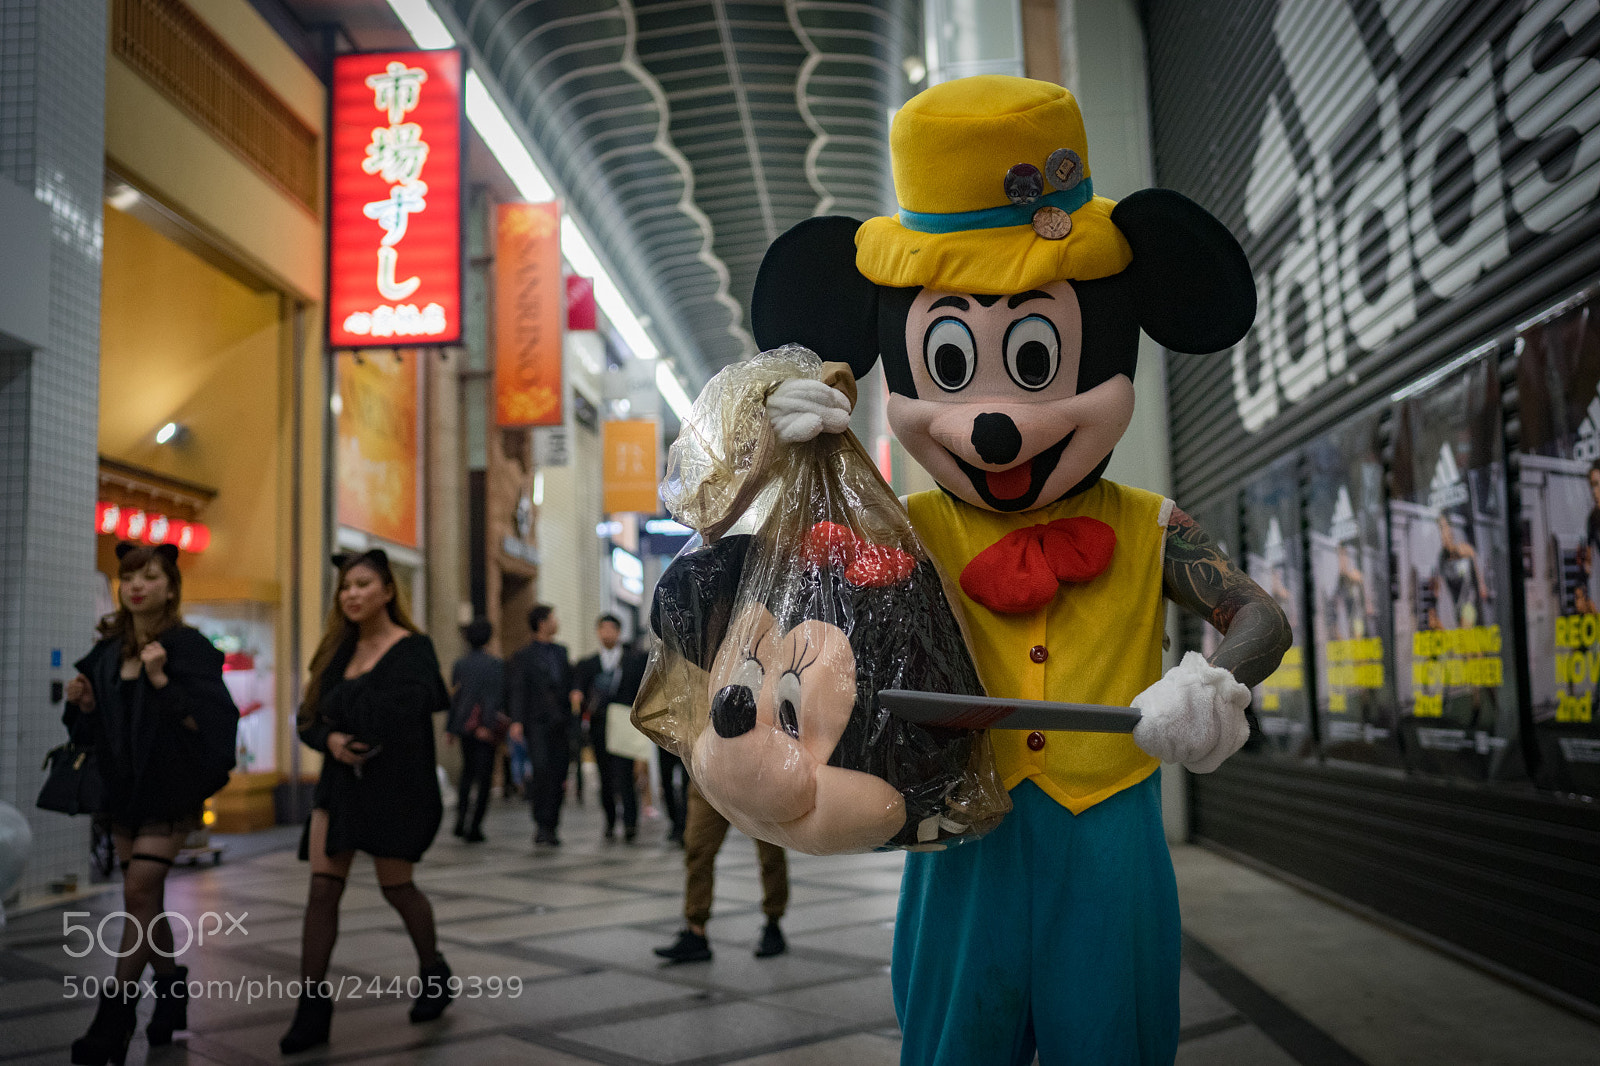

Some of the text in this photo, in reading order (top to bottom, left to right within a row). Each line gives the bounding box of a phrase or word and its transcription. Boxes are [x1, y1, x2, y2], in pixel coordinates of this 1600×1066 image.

[362, 61, 429, 301] 市場ずし
[1231, 0, 1600, 434] adidas
[1556, 690, 1592, 722] 2nd
